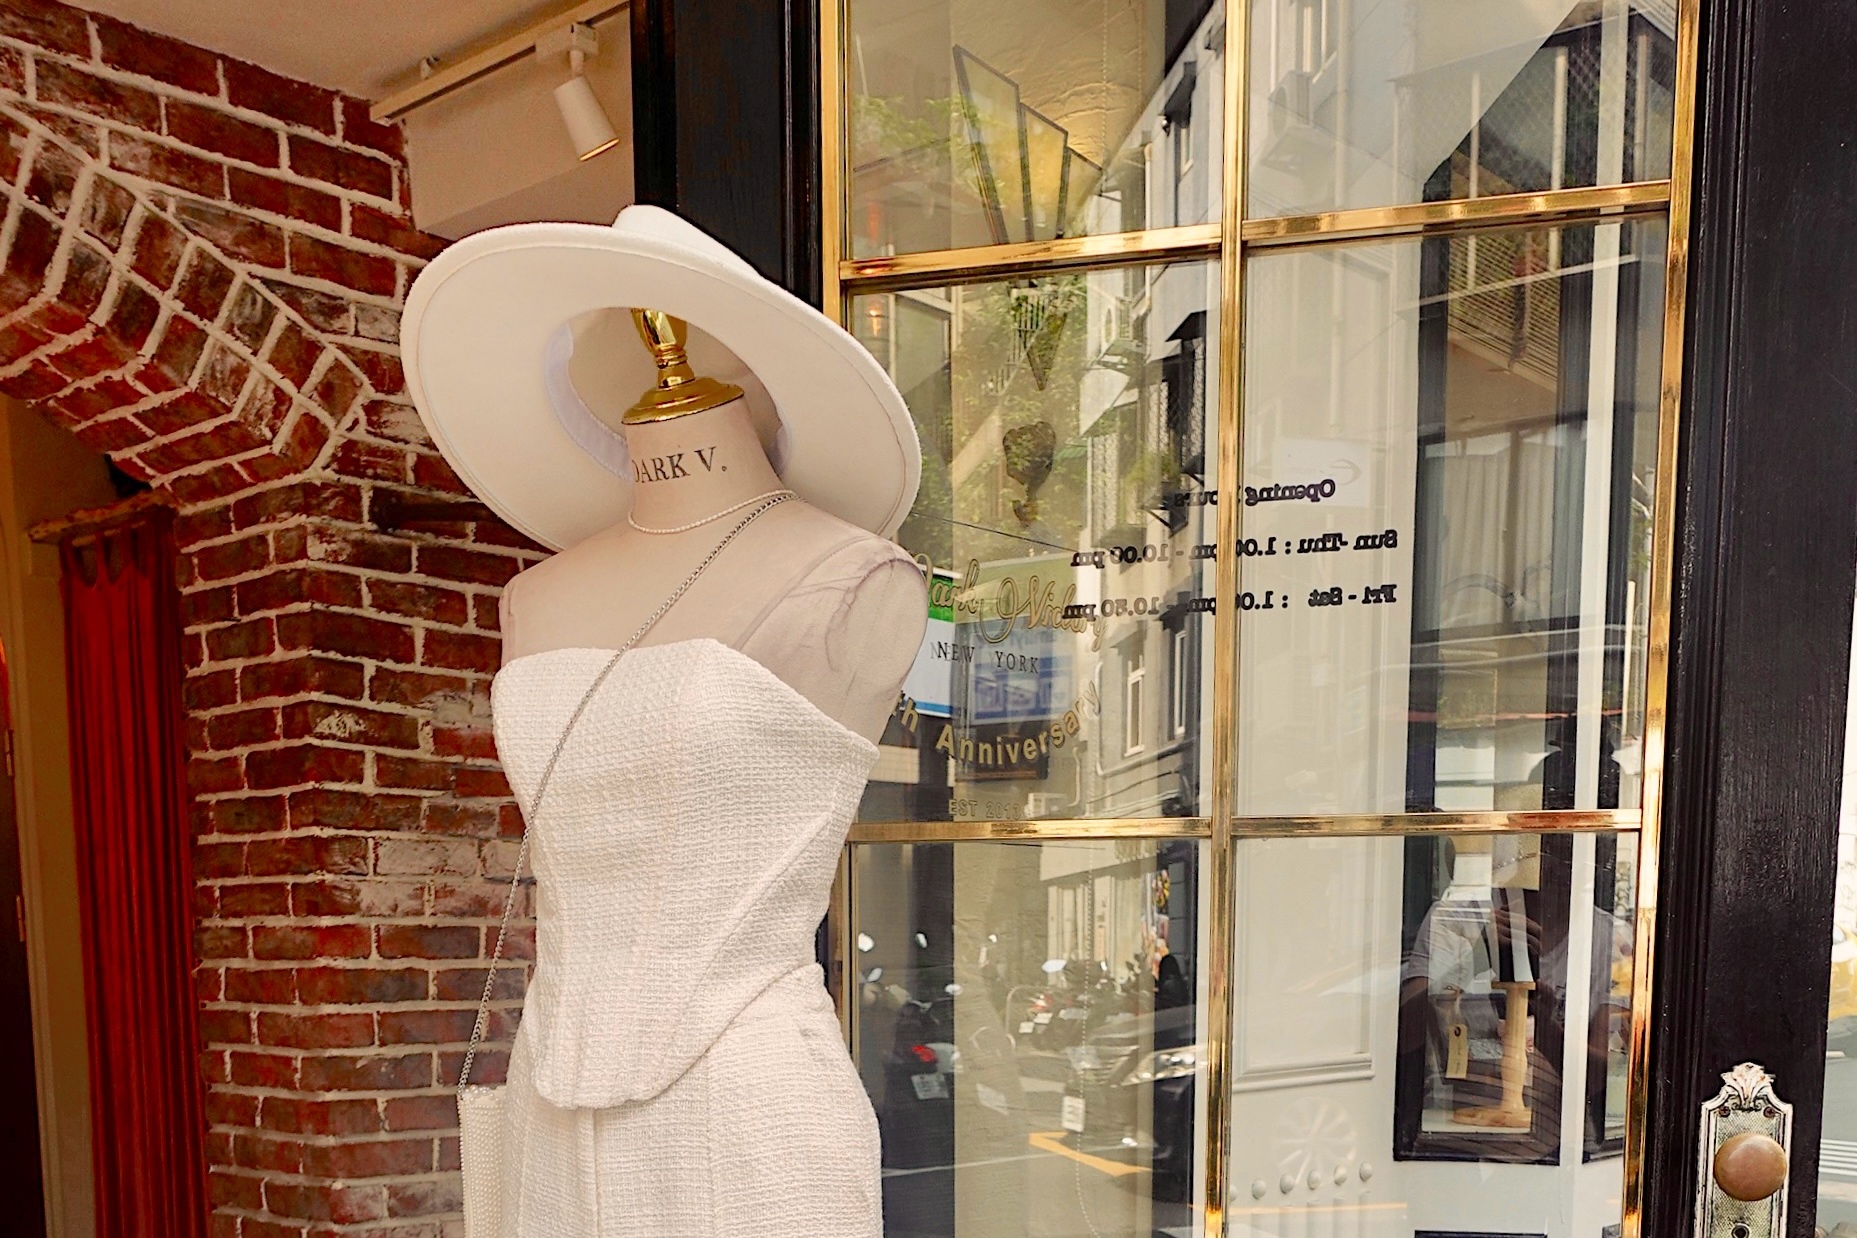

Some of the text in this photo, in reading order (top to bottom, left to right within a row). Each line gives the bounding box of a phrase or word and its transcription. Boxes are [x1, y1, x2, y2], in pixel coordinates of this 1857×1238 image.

[694, 446, 727, 472] V.
[938, 641, 975, 663] NEW
[995, 650, 1039, 674] YORK
[936, 681, 1100, 765] Anniversary
[949, 799, 978, 817] EST
